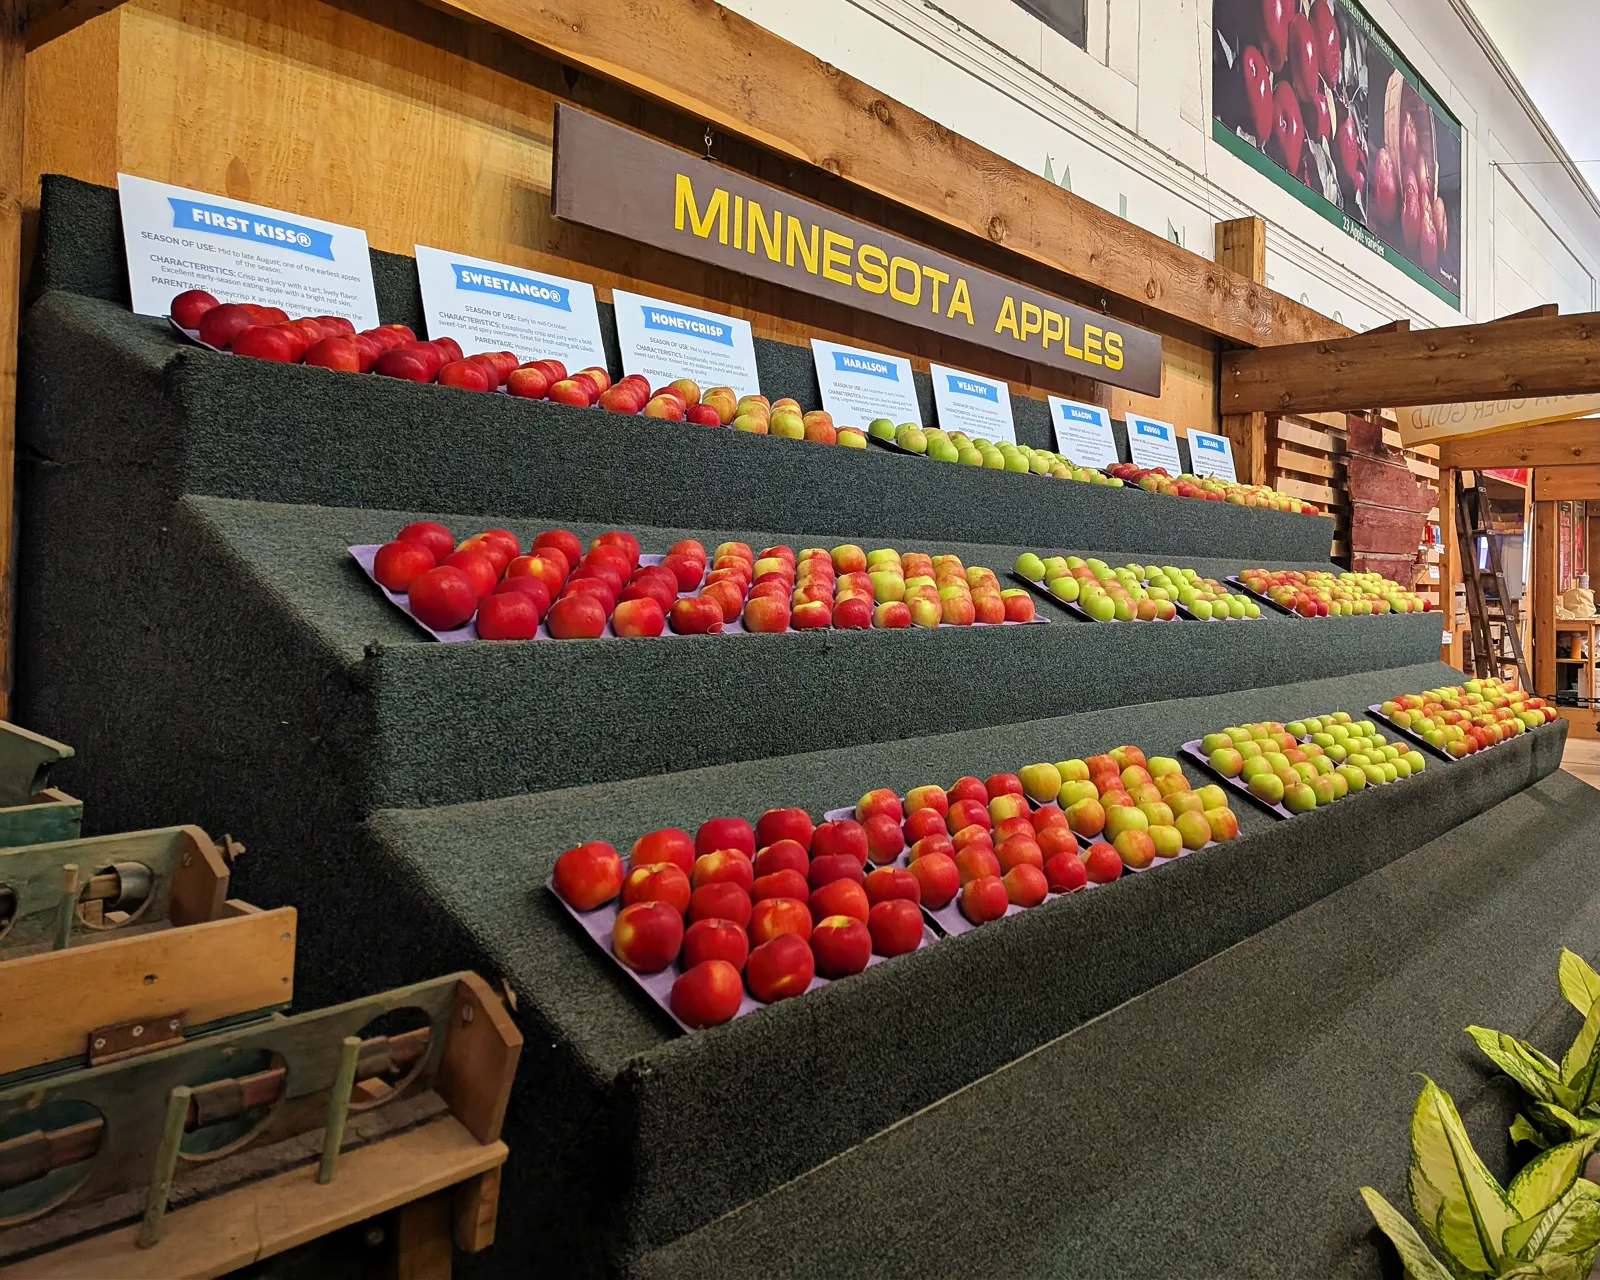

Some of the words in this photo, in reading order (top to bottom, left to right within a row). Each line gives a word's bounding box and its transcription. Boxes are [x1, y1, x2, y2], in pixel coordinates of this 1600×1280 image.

[192, 208, 249, 233] FIRST
[254, 222, 311, 247] KISS®
[1343, 216, 1349, 231] 23
[1350, 222, 1364, 242] Apple
[1365, 235, 1384, 256] varieties
[141, 231, 179, 245] SEASON
[197, 243, 216, 252] USE:
[317, 268, 339, 278] earliest
[341, 273, 360, 282] apples
[258, 264, 282, 274] season.
[150, 254, 236, 276] CHARACTERISTICS:
[238, 272, 255, 280] Crisp
[271, 279, 286, 288] juicy
[288, 282, 302, 290] with
[309, 286, 322, 294] tart,
[323, 288, 339, 298] lively
[340, 292, 358, 300] flavor.
[161, 266, 194, 278] Excellent
[197, 273, 240, 286] early-season
[243, 281, 264, 291] eating
[266, 286, 283, 294] apple
[285, 289, 299, 297] with
[306, 293, 325, 302] bright
[674, 174, 974, 324] MINNESOTA
[995, 296, 1124, 370] APPLES
[462, 270, 561, 303] SWEETANGO®
[211, 287, 249, 300] Honeycrisp
[268, 299, 284, 307] early
[285, 302, 312, 312] ripening
[313, 308, 334, 316] variety
[336, 310, 351, 318] from
[439, 312, 500, 328] CHARACTERISTICS:
[439, 320, 467, 329] sweet-tart
[465, 305, 491, 315] SEASON
[518, 316, 529, 324] Early
[537, 320, 567, 330] mid-October.
[651, 312, 723, 337] HONEYCRISP
[475, 336, 514, 348] PARENTAGE:
[650, 337, 670, 346] SEASON
[843, 357, 888, 373] HARALSON
[957, 380, 987, 395] WEALTHY
[1071, 410, 1092, 420] BEACON
